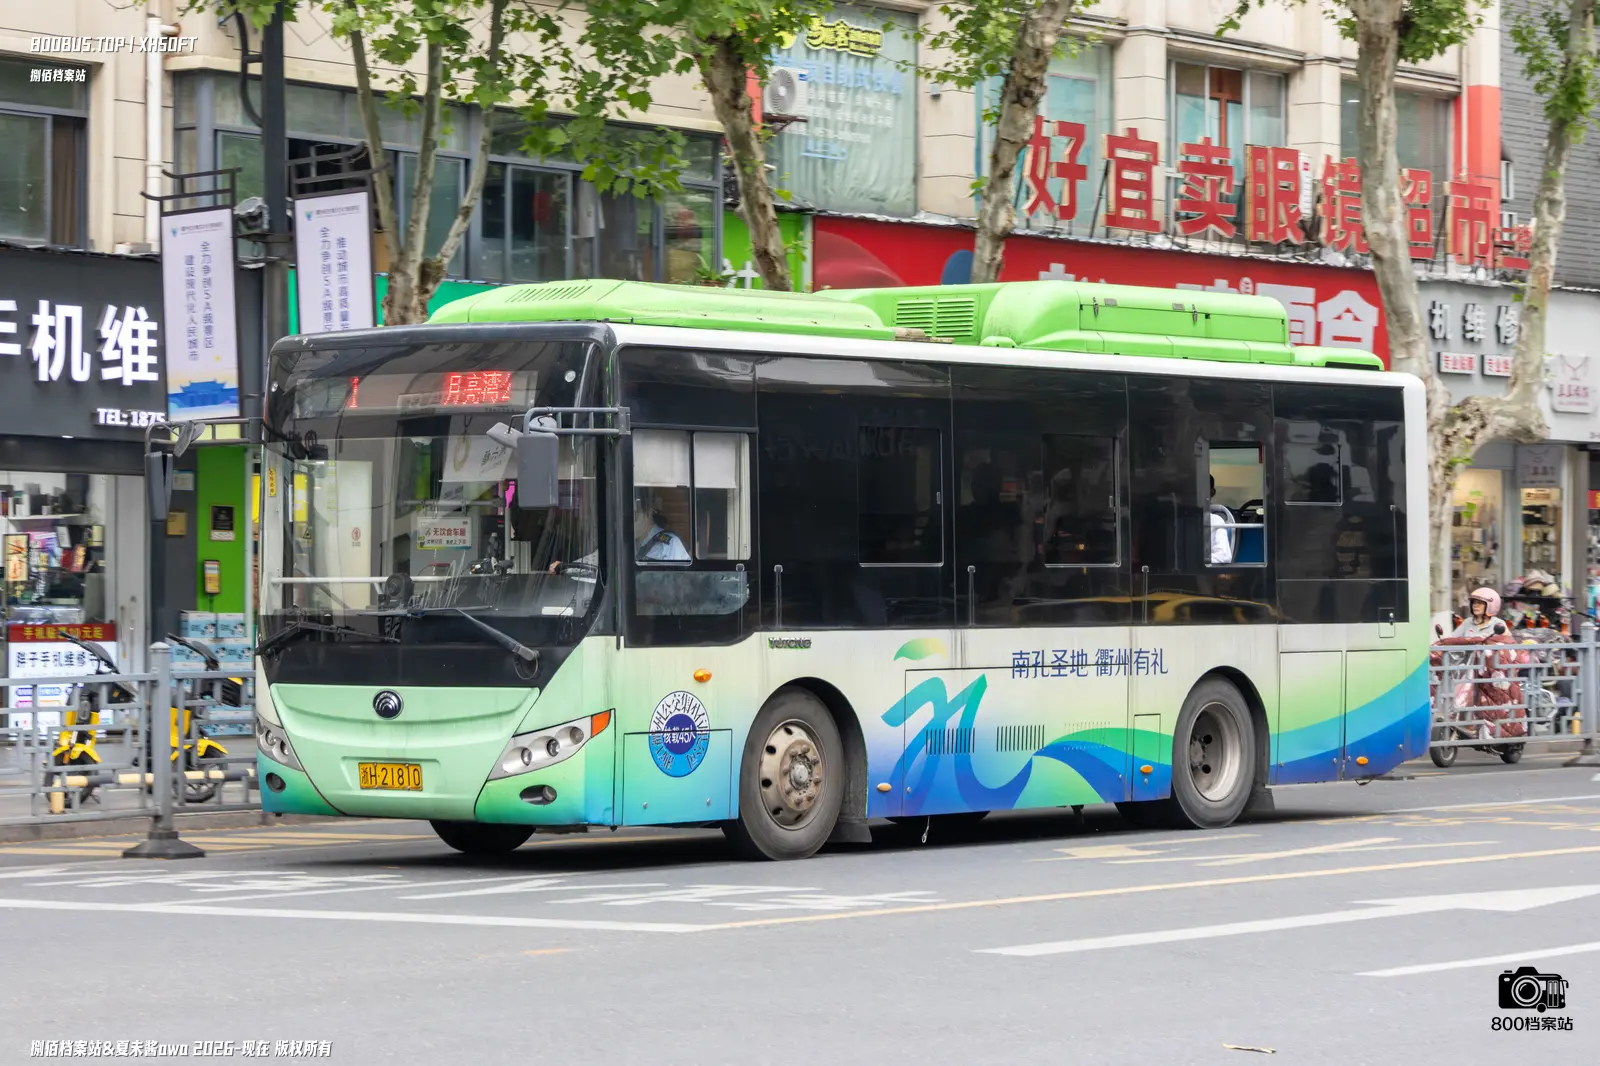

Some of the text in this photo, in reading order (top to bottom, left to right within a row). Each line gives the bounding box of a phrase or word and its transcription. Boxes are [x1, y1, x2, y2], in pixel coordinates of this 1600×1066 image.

[97, 408, 128, 425] TEL:
[1011, 647, 1169, 679] 南孔圣地 衢州有礼
